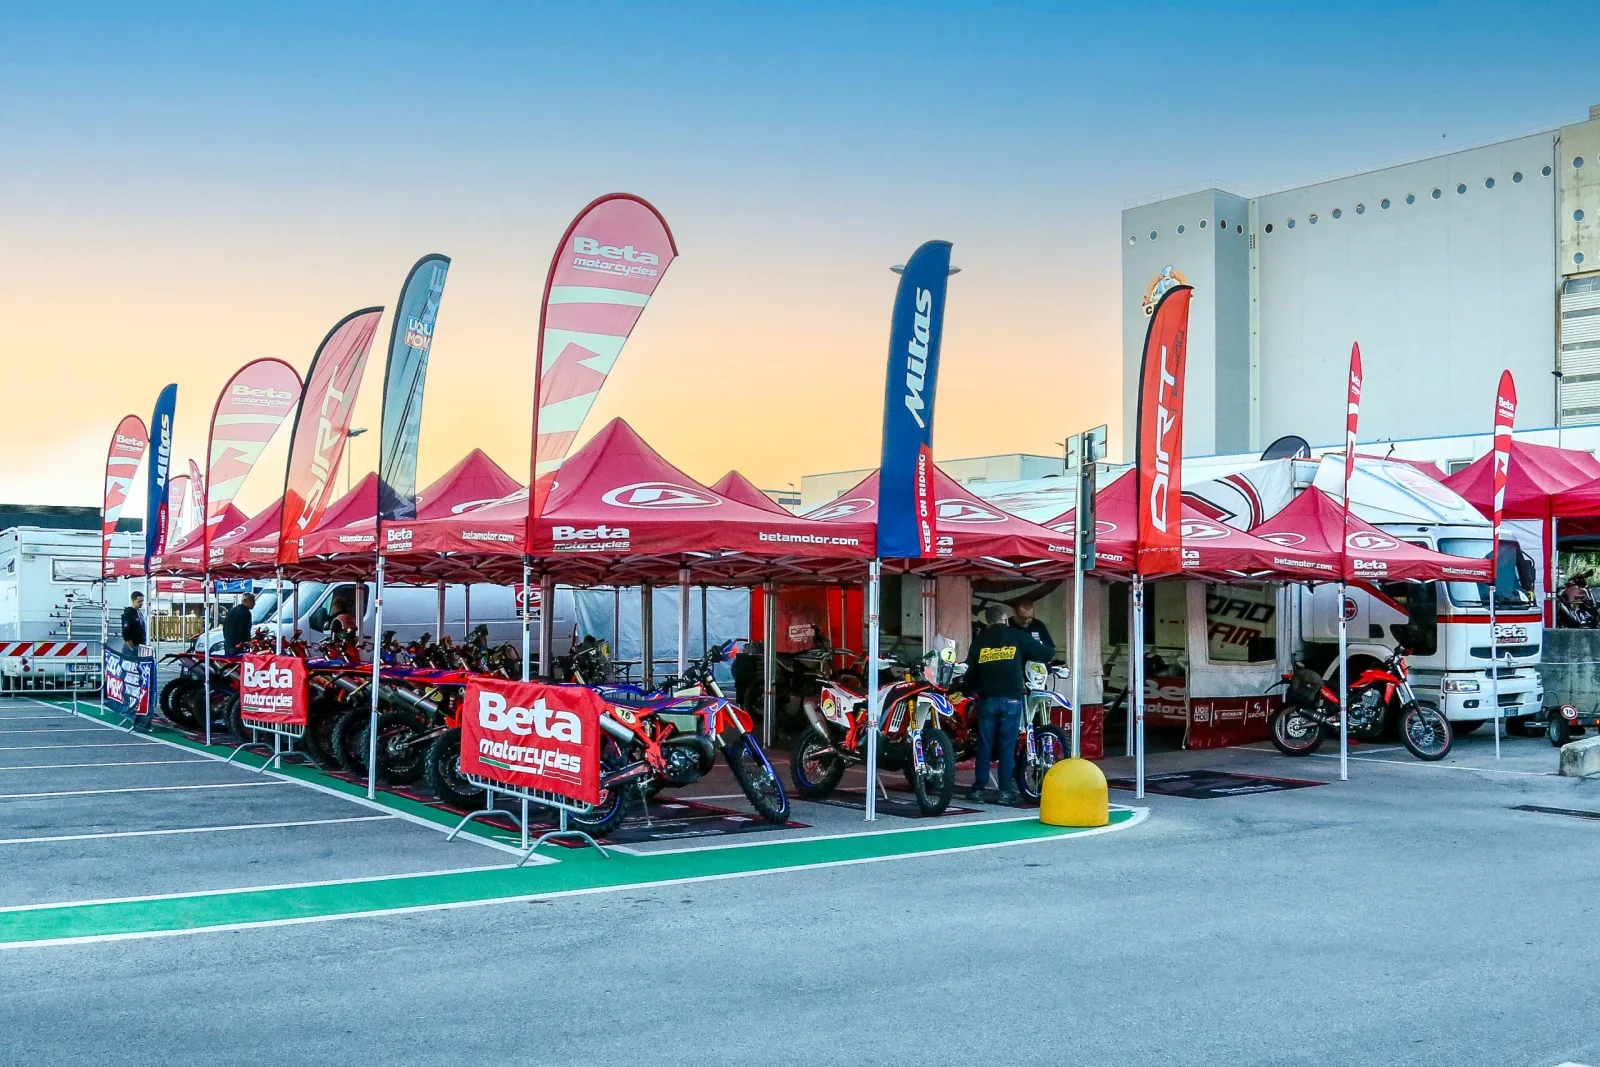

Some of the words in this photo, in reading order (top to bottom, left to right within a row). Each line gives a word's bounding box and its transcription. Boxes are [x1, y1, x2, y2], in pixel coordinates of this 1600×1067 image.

[573, 236, 660, 266] Beta
[573, 256, 658, 278] motorcycles
[409, 318, 433, 336] LIQU
[904, 287, 932, 428] Mitas
[232, 385, 292, 400] Beta
[231, 397, 290, 407] motorcycles
[1498, 396, 1514, 411] Beta
[116, 434, 144, 447] Beta
[297, 365, 344, 530] DIRT
[1150, 345, 1176, 533] DIRT
[157, 413, 171, 491] Mitas
[918, 453, 927, 497] RIDING
[919, 499, 928, 517] ON
[387, 528, 413, 541] Beta
[462, 530, 515, 543] betamotor.com
[552, 524, 630, 541] Beta
[759, 531, 859, 546] betamotor.com
[921, 520, 931, 553] KEEP
[553, 540, 630, 552] motorcycles
[1273, 556, 1333, 571] betamotor.com
[1353, 560, 1387, 570] Beta
[1441, 566, 1487, 577] betamotor.com
[1206, 595, 1276, 624] OAD
[1493, 624, 1527, 638] Beta
[947, 651, 952, 660] 7
[244, 662, 293, 688] Beta
[243, 692, 293, 712] motorcycles
[478, 691, 582, 745] Beta
[620, 709, 631, 720] 16
[479, 738, 582, 775] motorcycles
